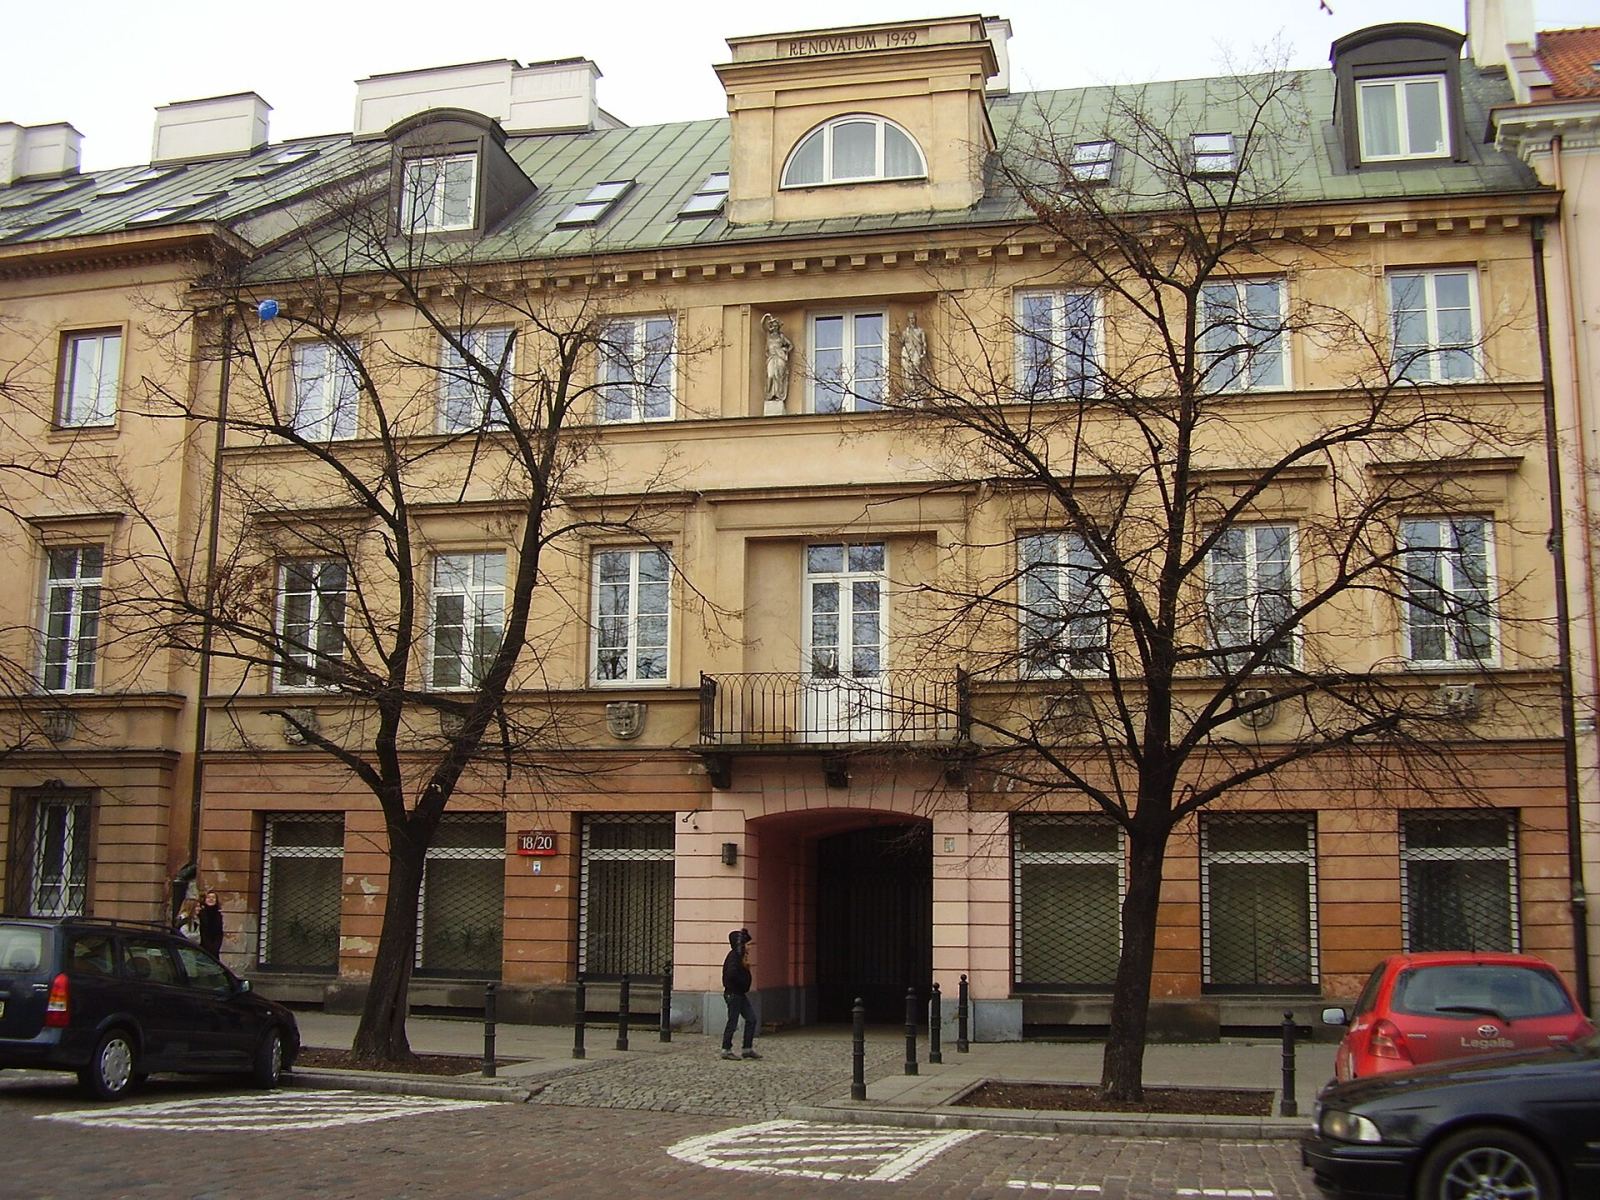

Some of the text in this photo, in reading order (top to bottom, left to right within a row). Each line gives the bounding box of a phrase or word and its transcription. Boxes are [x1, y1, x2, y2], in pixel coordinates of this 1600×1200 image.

[789, 31, 917, 56] RENOVATUM 1949
[522, 835, 552, 850] 18/20
